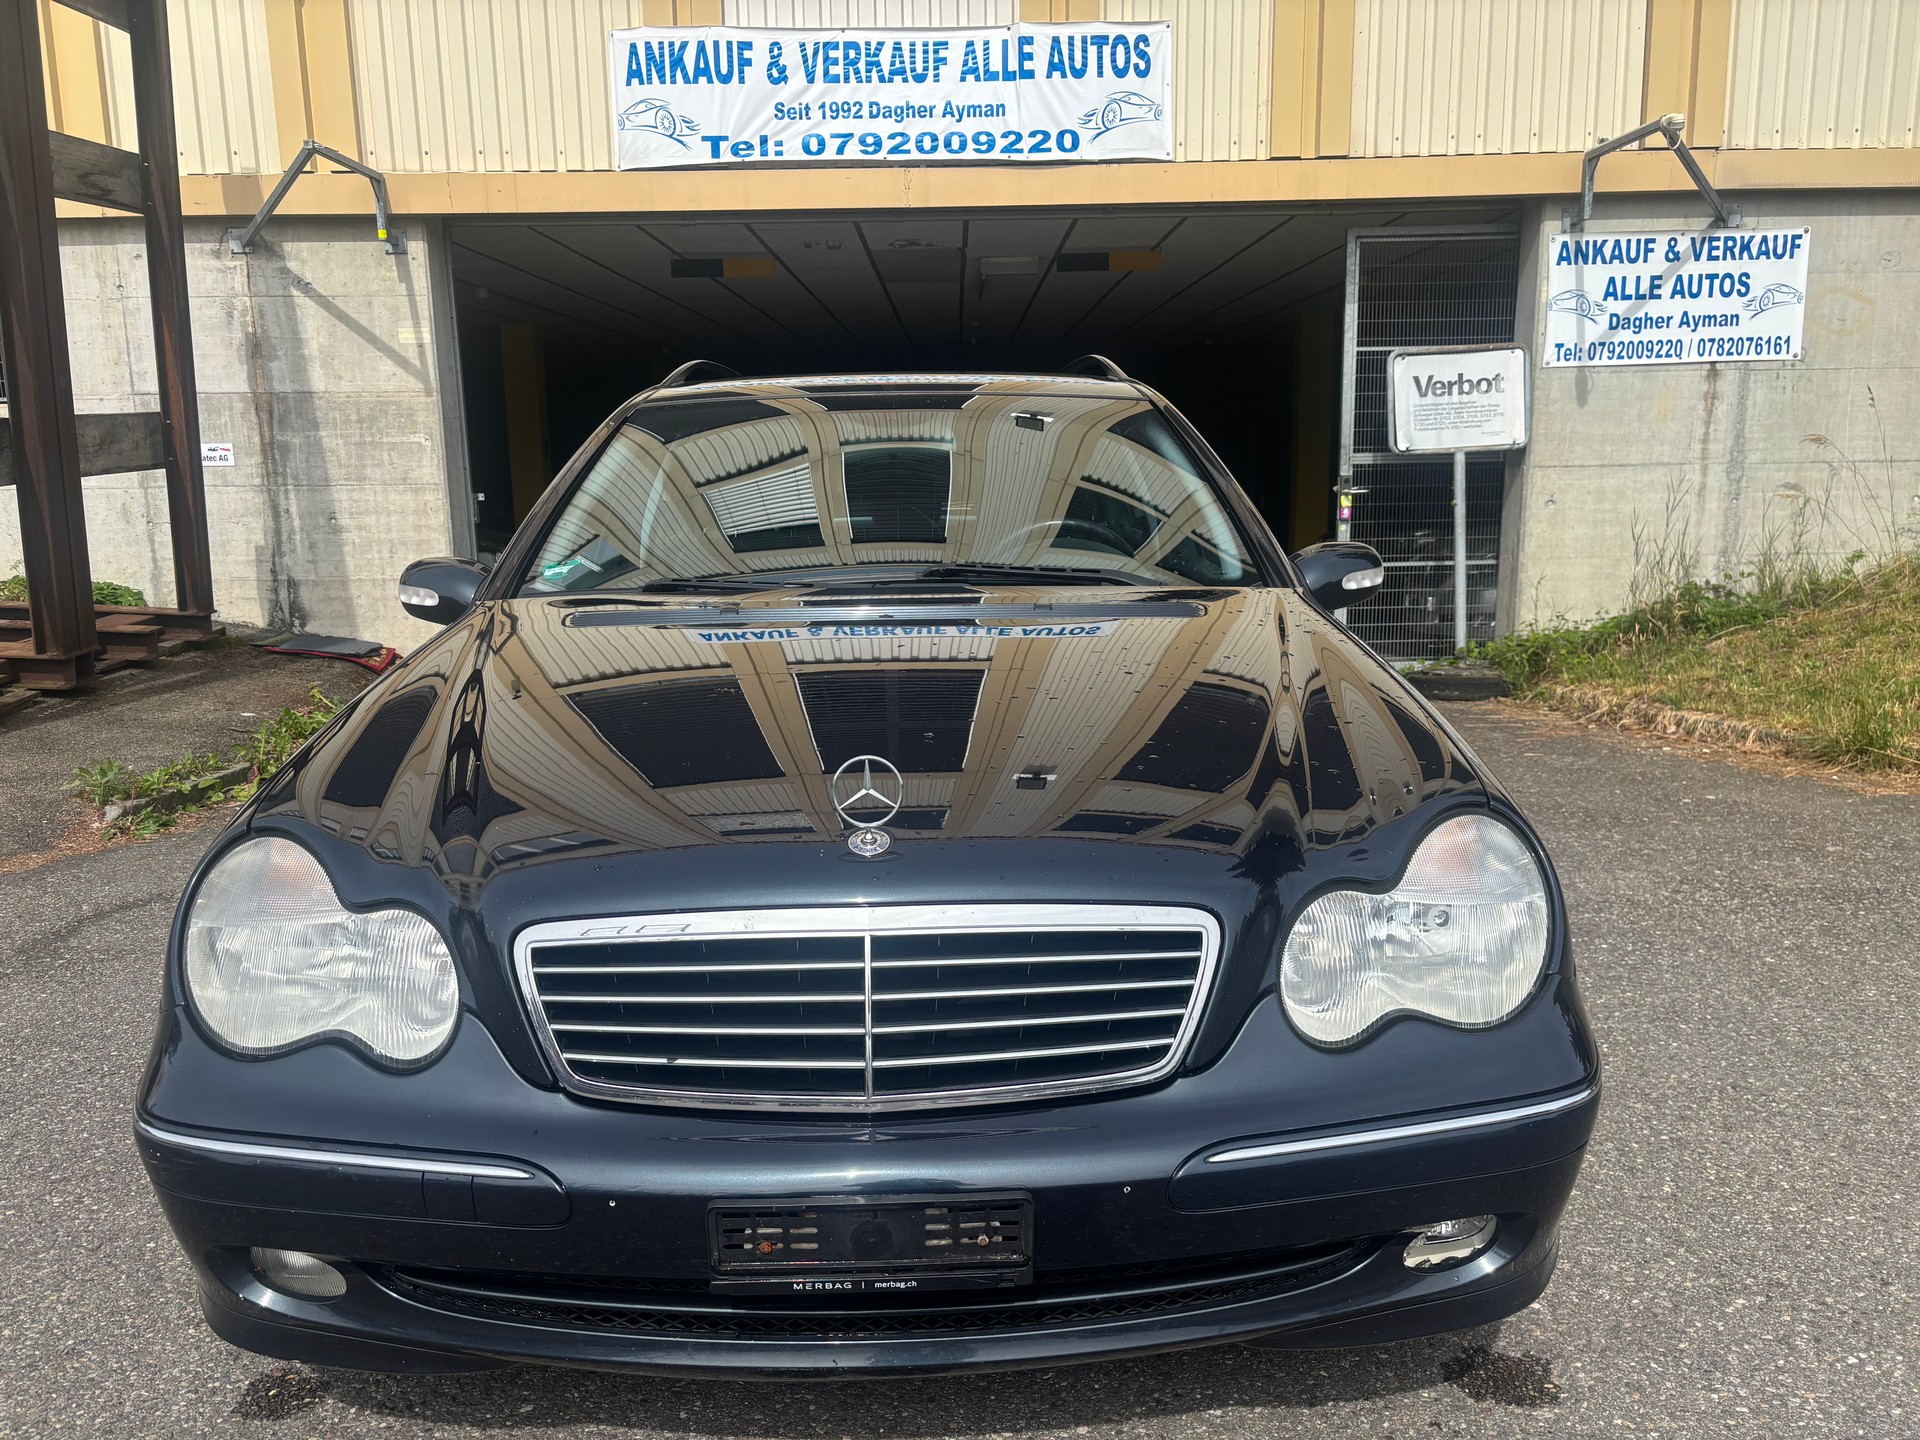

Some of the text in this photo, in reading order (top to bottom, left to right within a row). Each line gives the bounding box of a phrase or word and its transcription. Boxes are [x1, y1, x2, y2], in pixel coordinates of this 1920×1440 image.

[626, 34, 1151, 87] ANKAUF & VERKAUF ALLE AUTOS
[774, 100, 1006, 123] Seit 1992 Dagher Ayman
[701, 129, 1080, 159] Tel: 0792009220
[1556, 234, 1803, 266] ANKAUF & VERKAUF
[1603, 272, 1750, 301] ALLE AUTOS
[1609, 311, 1740, 335] Dagher Ayman
[1555, 336, 1790, 362] Tel: 0792009220 / 0782076161
[1412, 372, 1505, 398] Verbot
[793, 1282, 852, 1290] MERBAG
[874, 1280, 917, 1289] merbag.ch
